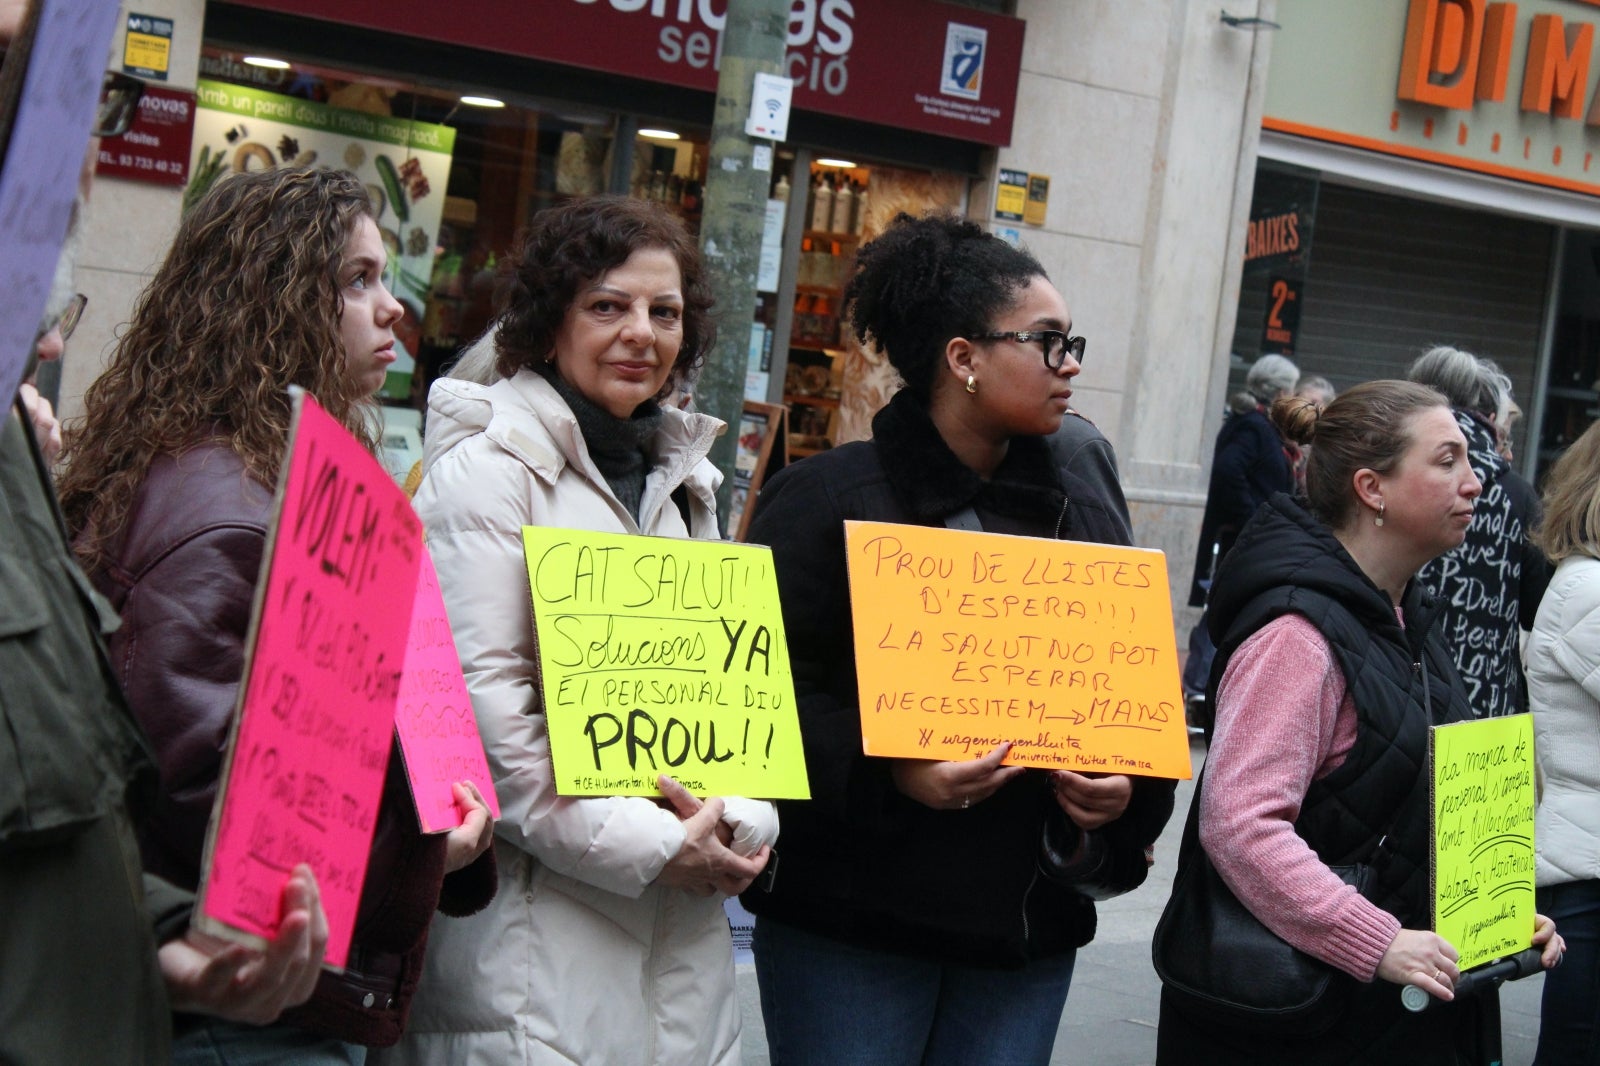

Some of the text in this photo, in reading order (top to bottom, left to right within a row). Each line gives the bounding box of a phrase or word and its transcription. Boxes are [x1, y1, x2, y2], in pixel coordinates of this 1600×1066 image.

[657, 25, 849, 95] selció
[1397, 0, 1600, 126] DIM
[138, 95, 188, 115] novas
[197, 87, 229, 106] Amb
[232, 95, 251, 111] un
[254, 99, 293, 120] parell
[98, 150, 117, 164] EL.
[1244, 212, 1299, 260] BAIXES
[536, 542, 624, 603] CAT
[863, 536, 1151, 588] PROU DE LLISTES
[551, 614, 706, 668] Solucions
[878, 623, 1160, 666] LA SALUT NO POT
[602, 679, 728, 706] PERSONAL
[744, 685, 782, 710] DIU
[951, 661, 1114, 692] ESPERAR
[876, 691, 1175, 725] NECESSITEM MANS
[583, 708, 774, 771] PROU!!
[1464, 744, 1508, 773] manca
[1513, 727, 1526, 763] de
